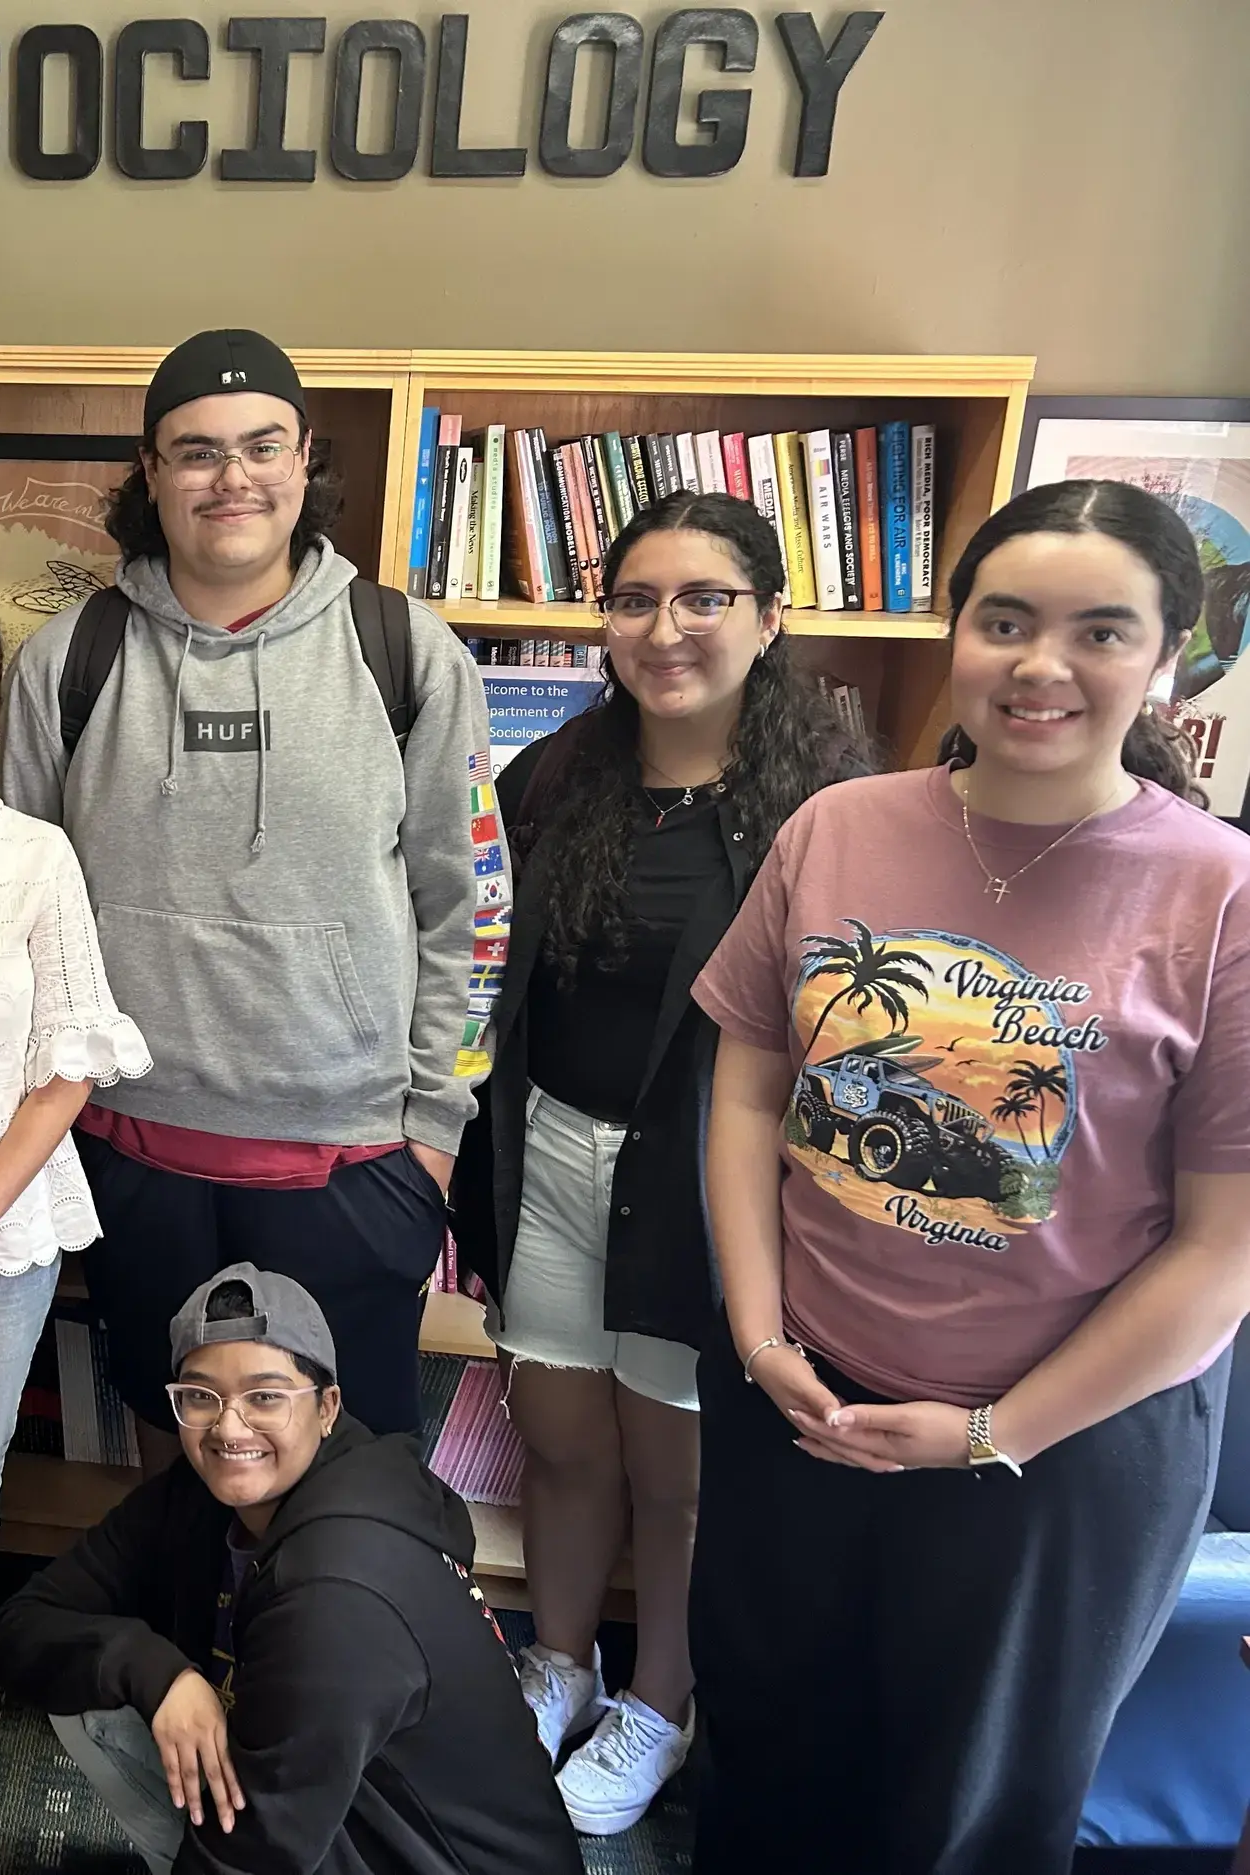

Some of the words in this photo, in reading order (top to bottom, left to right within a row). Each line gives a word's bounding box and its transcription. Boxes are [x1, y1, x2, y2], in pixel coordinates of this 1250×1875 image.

[839, 440, 847, 461] PERSE
[655, 459, 663, 481] MEDIA
[733, 469, 742, 487] MASS
[840, 469, 850, 494] MEDIA
[923, 463, 931, 497] MEDIA,
[34, 493, 69, 509] are
[467, 491, 478, 519] Making
[556, 461, 571, 521] COMMUNICATION
[565, 522, 575, 556] MODELS
[763, 482, 774, 518] MEDIA
[819, 487, 829, 508] AIR
[894, 496, 906, 523] FOR
[540, 493, 548, 518] PUBLIC
[544, 519, 552, 544] POLICY
[788, 463, 796, 495] American
[797, 550, 805, 573] Culture
[842, 498, 852, 530] EFFECTS
[923, 500, 931, 527] POOR
[468, 534, 476, 554] News
[821, 514, 832, 549] WARS
[844, 533, 854, 551] AND
[894, 527, 906, 548] AIR
[846, 552, 855, 586] SOCIETY
[922, 530, 930, 587] DEMOCRACY
[484, 683, 528, 696] elcome
[531, 685, 544, 696] to
[548, 685, 568, 696] the
[489, 708, 548, 719] partment
[551, 707, 565, 718] of
[197, 722, 254, 741] HUF
[490, 727, 548, 741] Sociology
[945, 958, 1091, 1006] Virginia
[991, 1005, 1107, 1052] Beach
[884, 1195, 1007, 1252] Virginia
